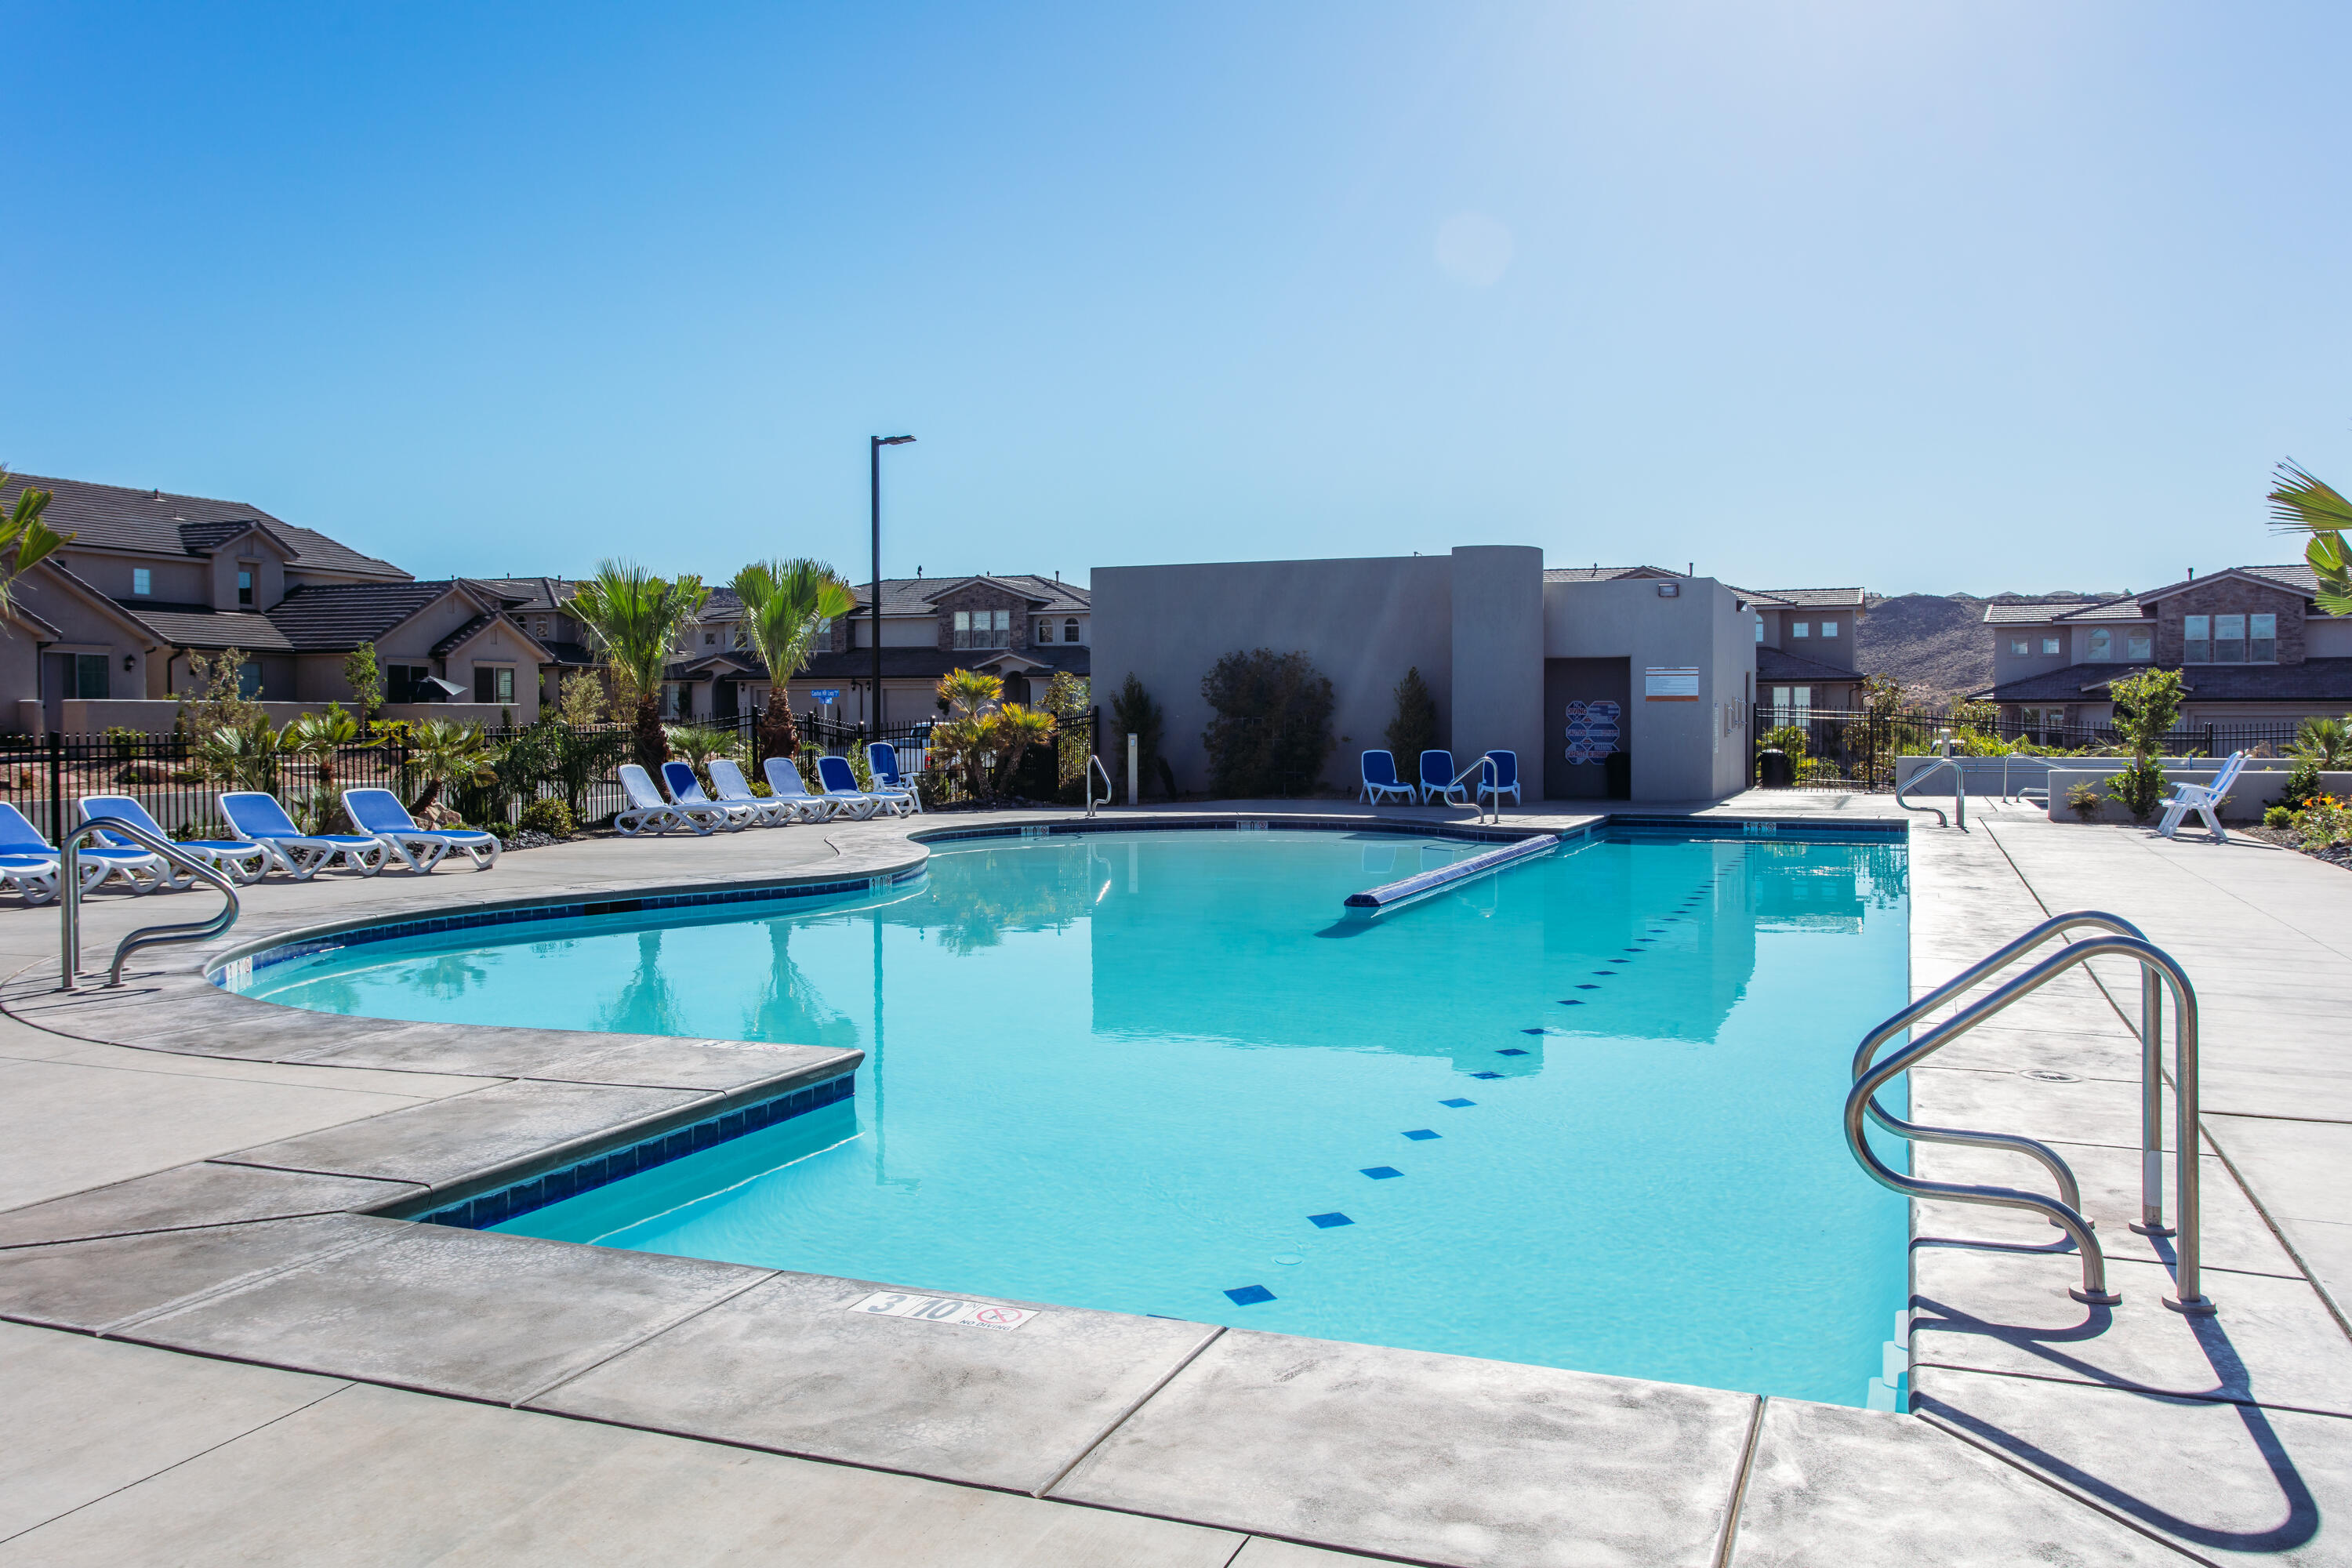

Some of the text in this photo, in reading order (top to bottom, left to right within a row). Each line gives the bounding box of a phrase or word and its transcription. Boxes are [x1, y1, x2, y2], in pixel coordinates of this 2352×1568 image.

[867, 1294, 907, 1312] 3
[912, 1299, 964, 1319] 10
[975, 1322, 1011, 1330] DIVING
